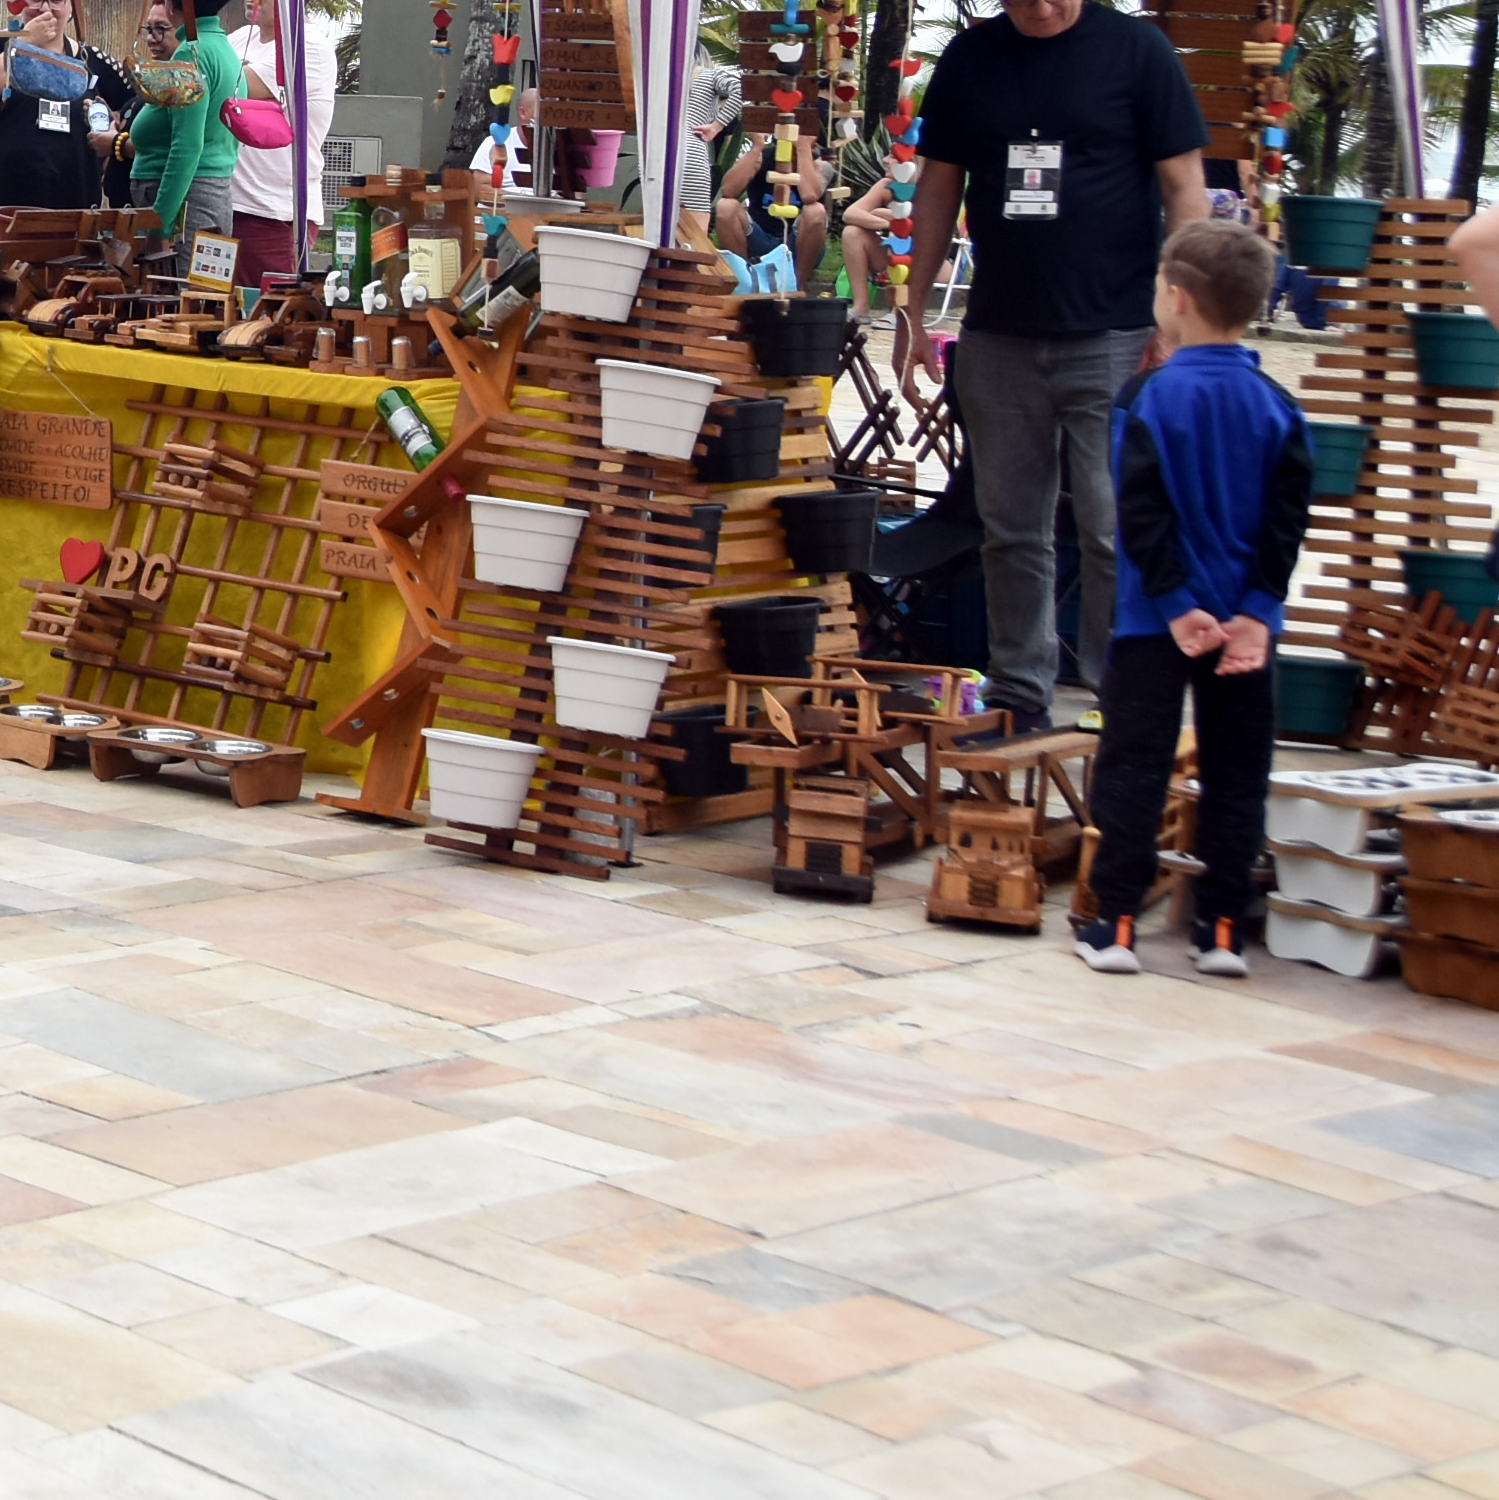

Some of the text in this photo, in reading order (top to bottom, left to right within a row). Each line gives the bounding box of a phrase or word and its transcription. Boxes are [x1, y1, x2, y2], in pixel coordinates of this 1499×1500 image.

[544, 105, 596, 123] PODER
[36, 416, 107, 438] GRANDE
[65, 465, 106, 483] EXIGE
[325, 548, 377, 572] PRAIA
[104, 546, 173, 602] PG
